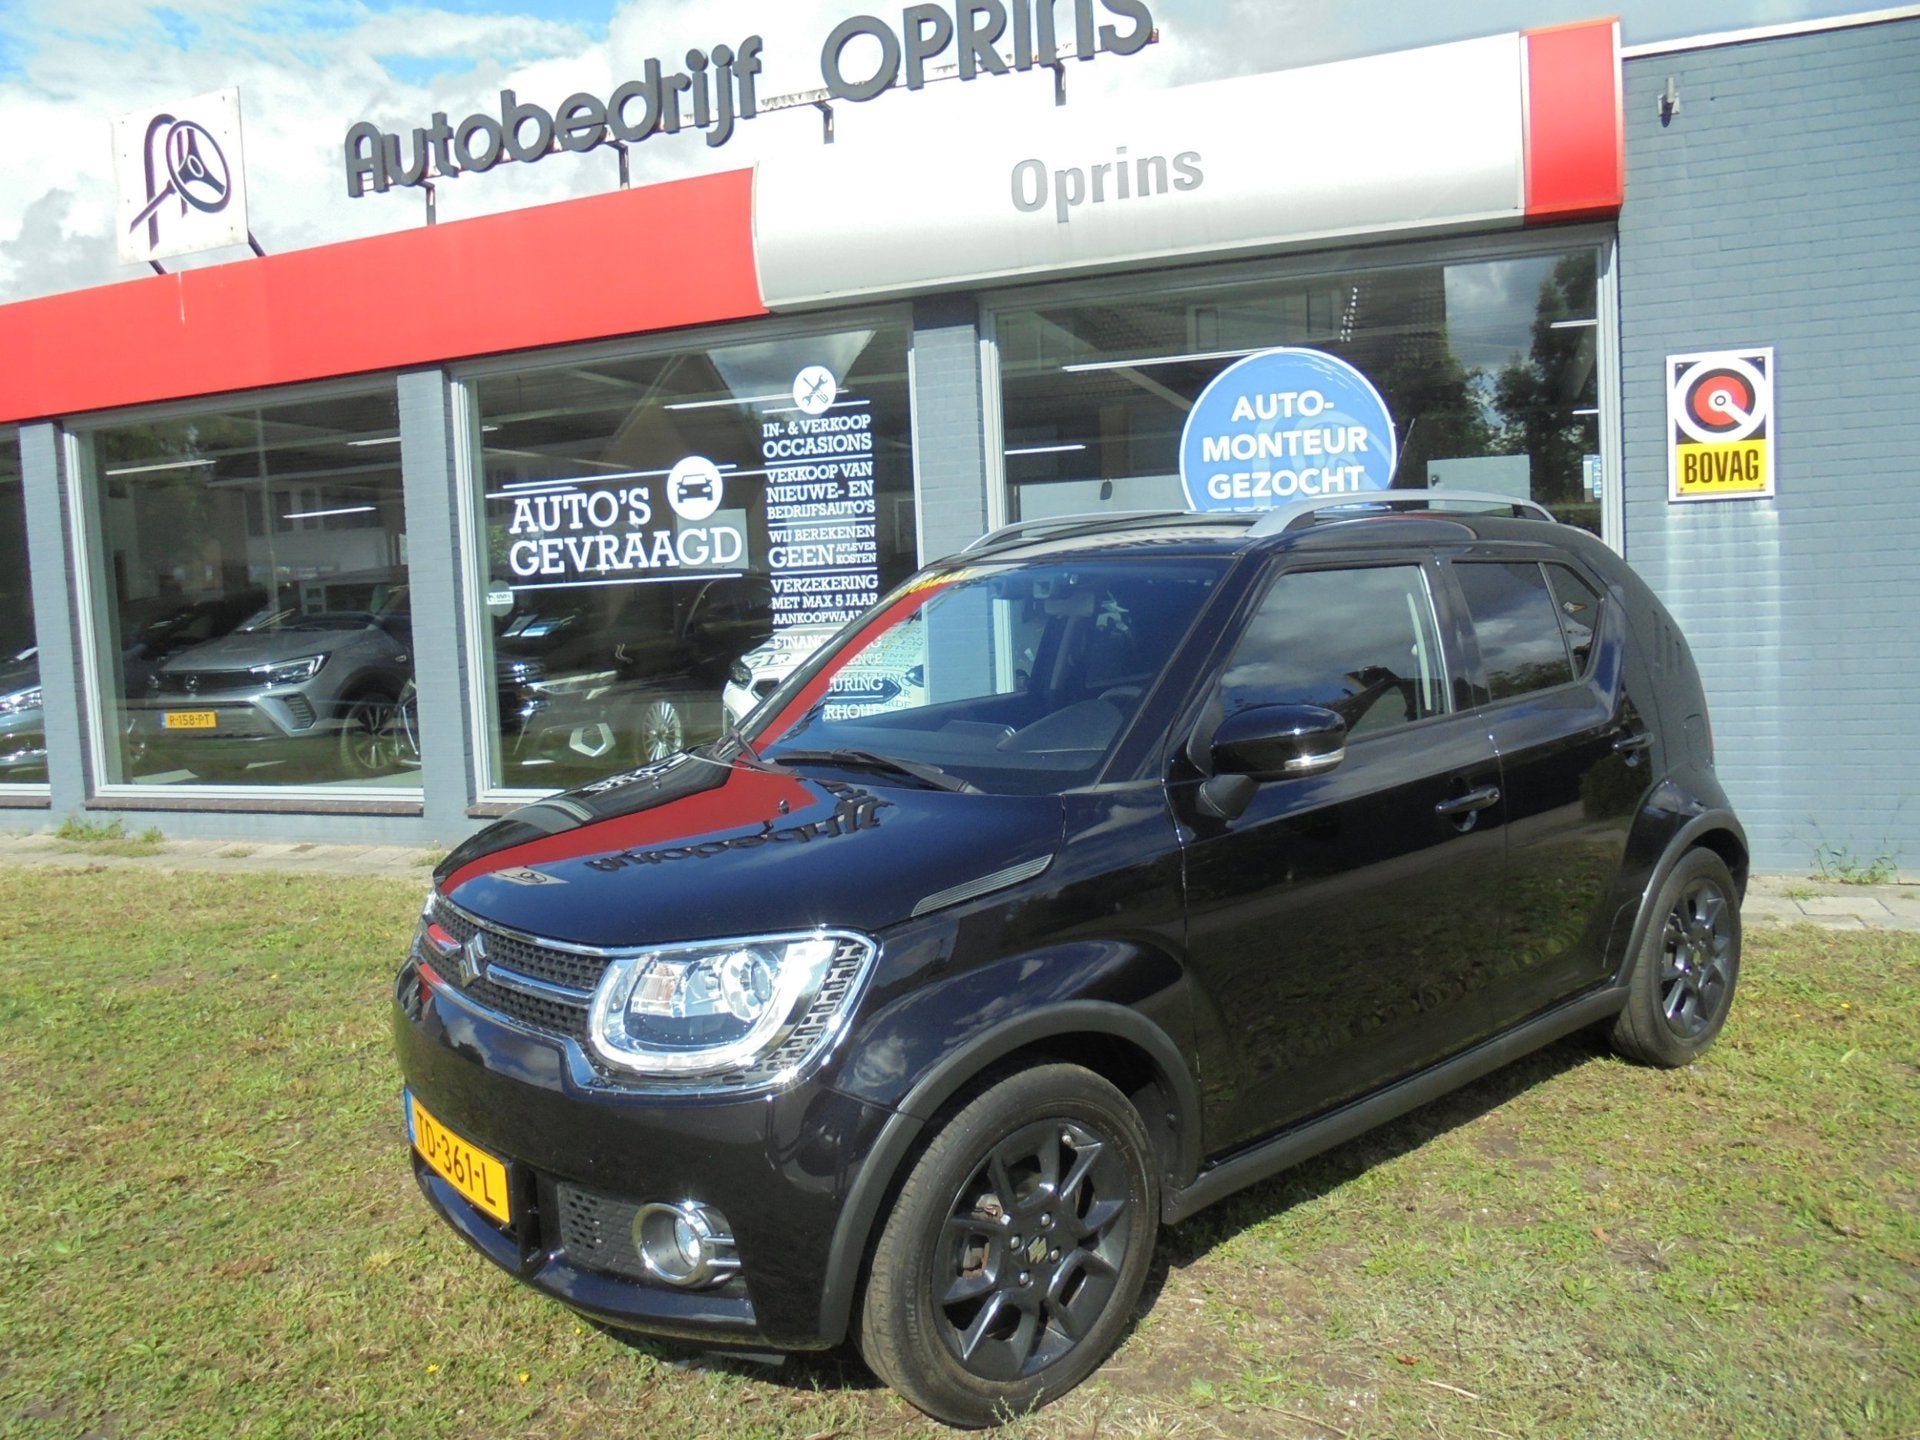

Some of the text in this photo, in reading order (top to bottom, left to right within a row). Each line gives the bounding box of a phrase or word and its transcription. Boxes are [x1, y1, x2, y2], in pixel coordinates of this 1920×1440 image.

[344, 35, 763, 199] Autobedrijf
[1011, 146, 1204, 224] Oprins
[1231, 390, 1335, 423] AUTO-
[762, 414, 871, 438] IN- & VERKOOP
[762, 432, 873, 458] OCCASIONS
[1202, 426, 1369, 463] MONTEUR
[765, 461, 873, 484] VERKOOP VAN
[1684, 449, 1759, 484] BOVAG
[765, 480, 874, 504] NIEUWE- EN
[1207, 465, 1365, 500] GEZOCHT
[509, 487, 652, 535] AUTO'S
[767, 499, 876, 520] BEDRIJFSAUTO'S
[768, 524, 876, 543] WIJ BEREKENEN
[509, 526, 743, 577] GEVRAAGD
[768, 544, 836, 568] GEEN
[836, 541, 877, 552] AFLEVER
[836, 553, 877, 565] KOSTEN
[770, 574, 879, 594] VERZEKERING
[771, 597, 801, 610] MET
[802, 595, 833, 609] MAX
[416, 1109, 497, 1208] TD-361-L
